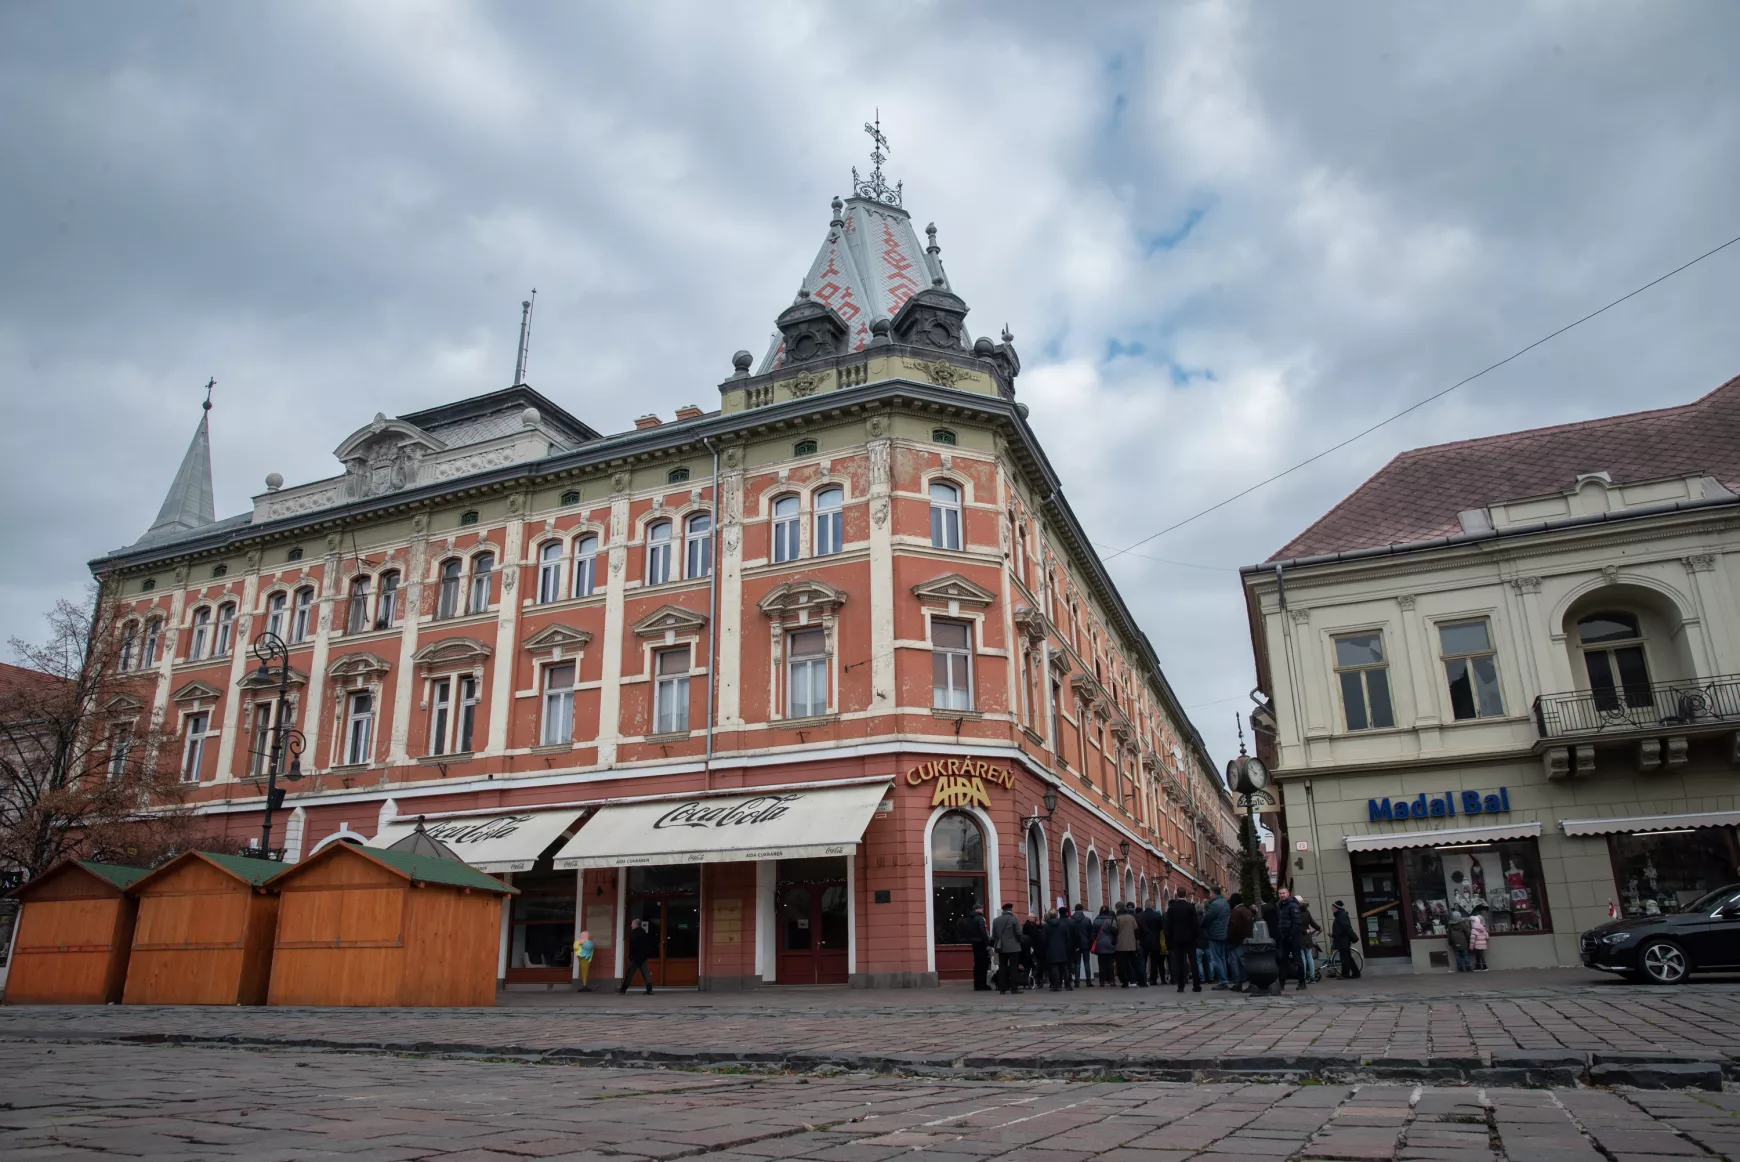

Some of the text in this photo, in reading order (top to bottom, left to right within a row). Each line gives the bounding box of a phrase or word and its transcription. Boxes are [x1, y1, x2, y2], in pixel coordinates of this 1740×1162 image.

[906, 756, 1015, 790] CUKRÁREŇ
[930, 776, 992, 807] AIDA
[1368, 786, 1511, 823] Madal Bal
